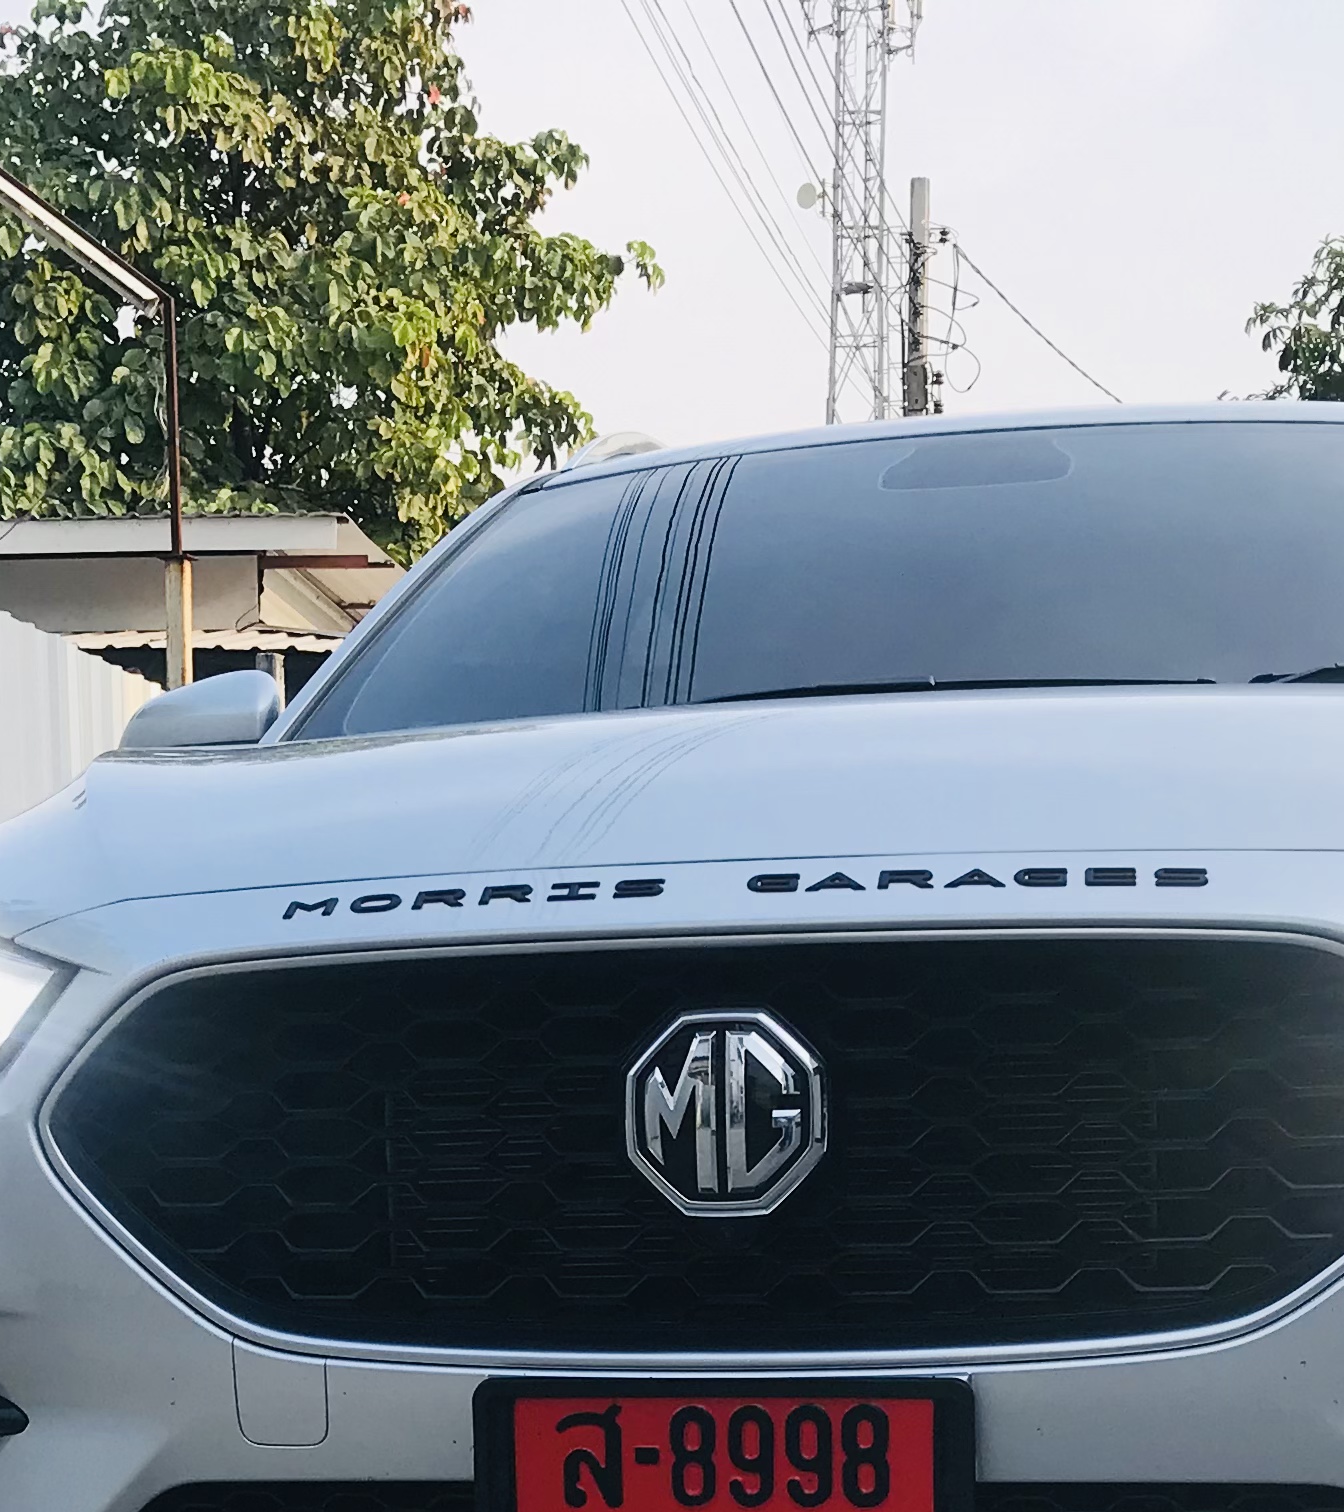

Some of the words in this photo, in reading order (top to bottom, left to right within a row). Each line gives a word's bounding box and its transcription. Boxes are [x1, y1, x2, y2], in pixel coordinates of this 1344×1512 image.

[282, 878, 666, 920] MORRIS
[746, 867, 1209, 893] GARAGES
[644, 1030, 802, 1194] MG
